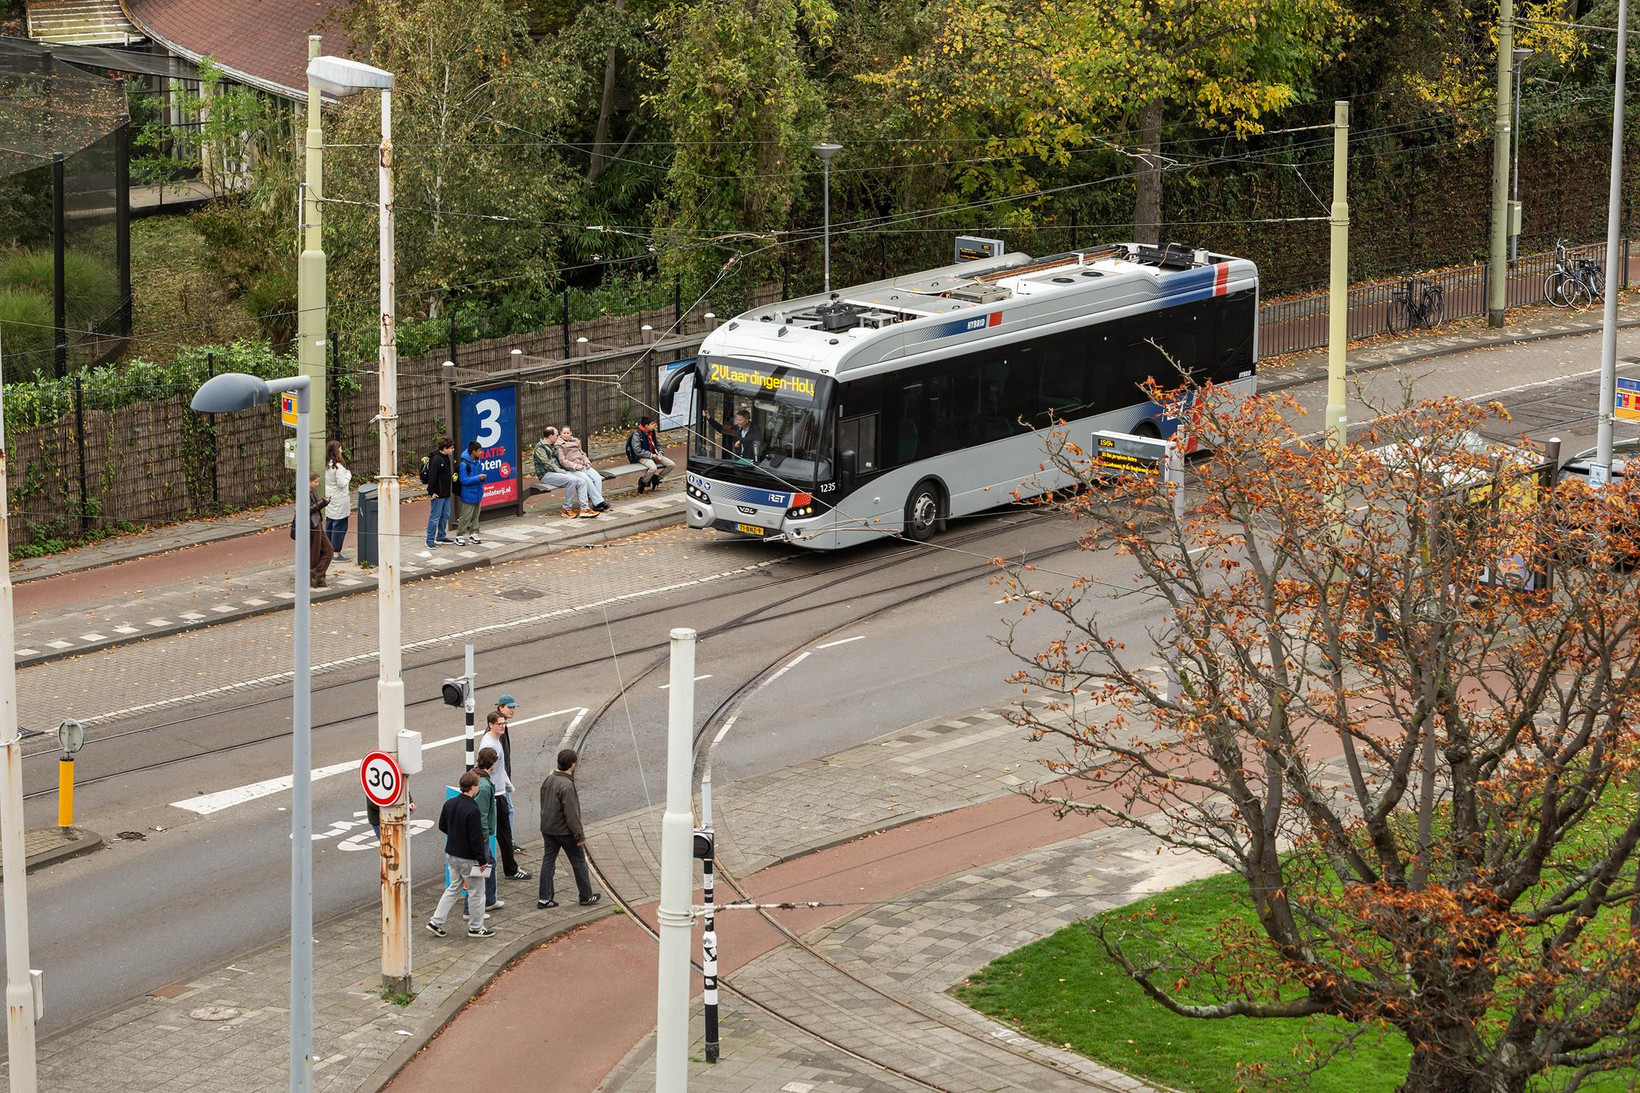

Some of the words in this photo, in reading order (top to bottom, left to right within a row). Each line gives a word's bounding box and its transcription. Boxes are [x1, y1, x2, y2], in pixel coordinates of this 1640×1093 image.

[711, 364, 719, 381] 2
[475, 398, 502, 448] 3
[479, 445, 505, 460] RATIS
[820, 482, 836, 492] 1235
[768, 493, 786, 504] RET
[739, 506, 755, 514] VDL
[368, 767, 394, 791] 30
